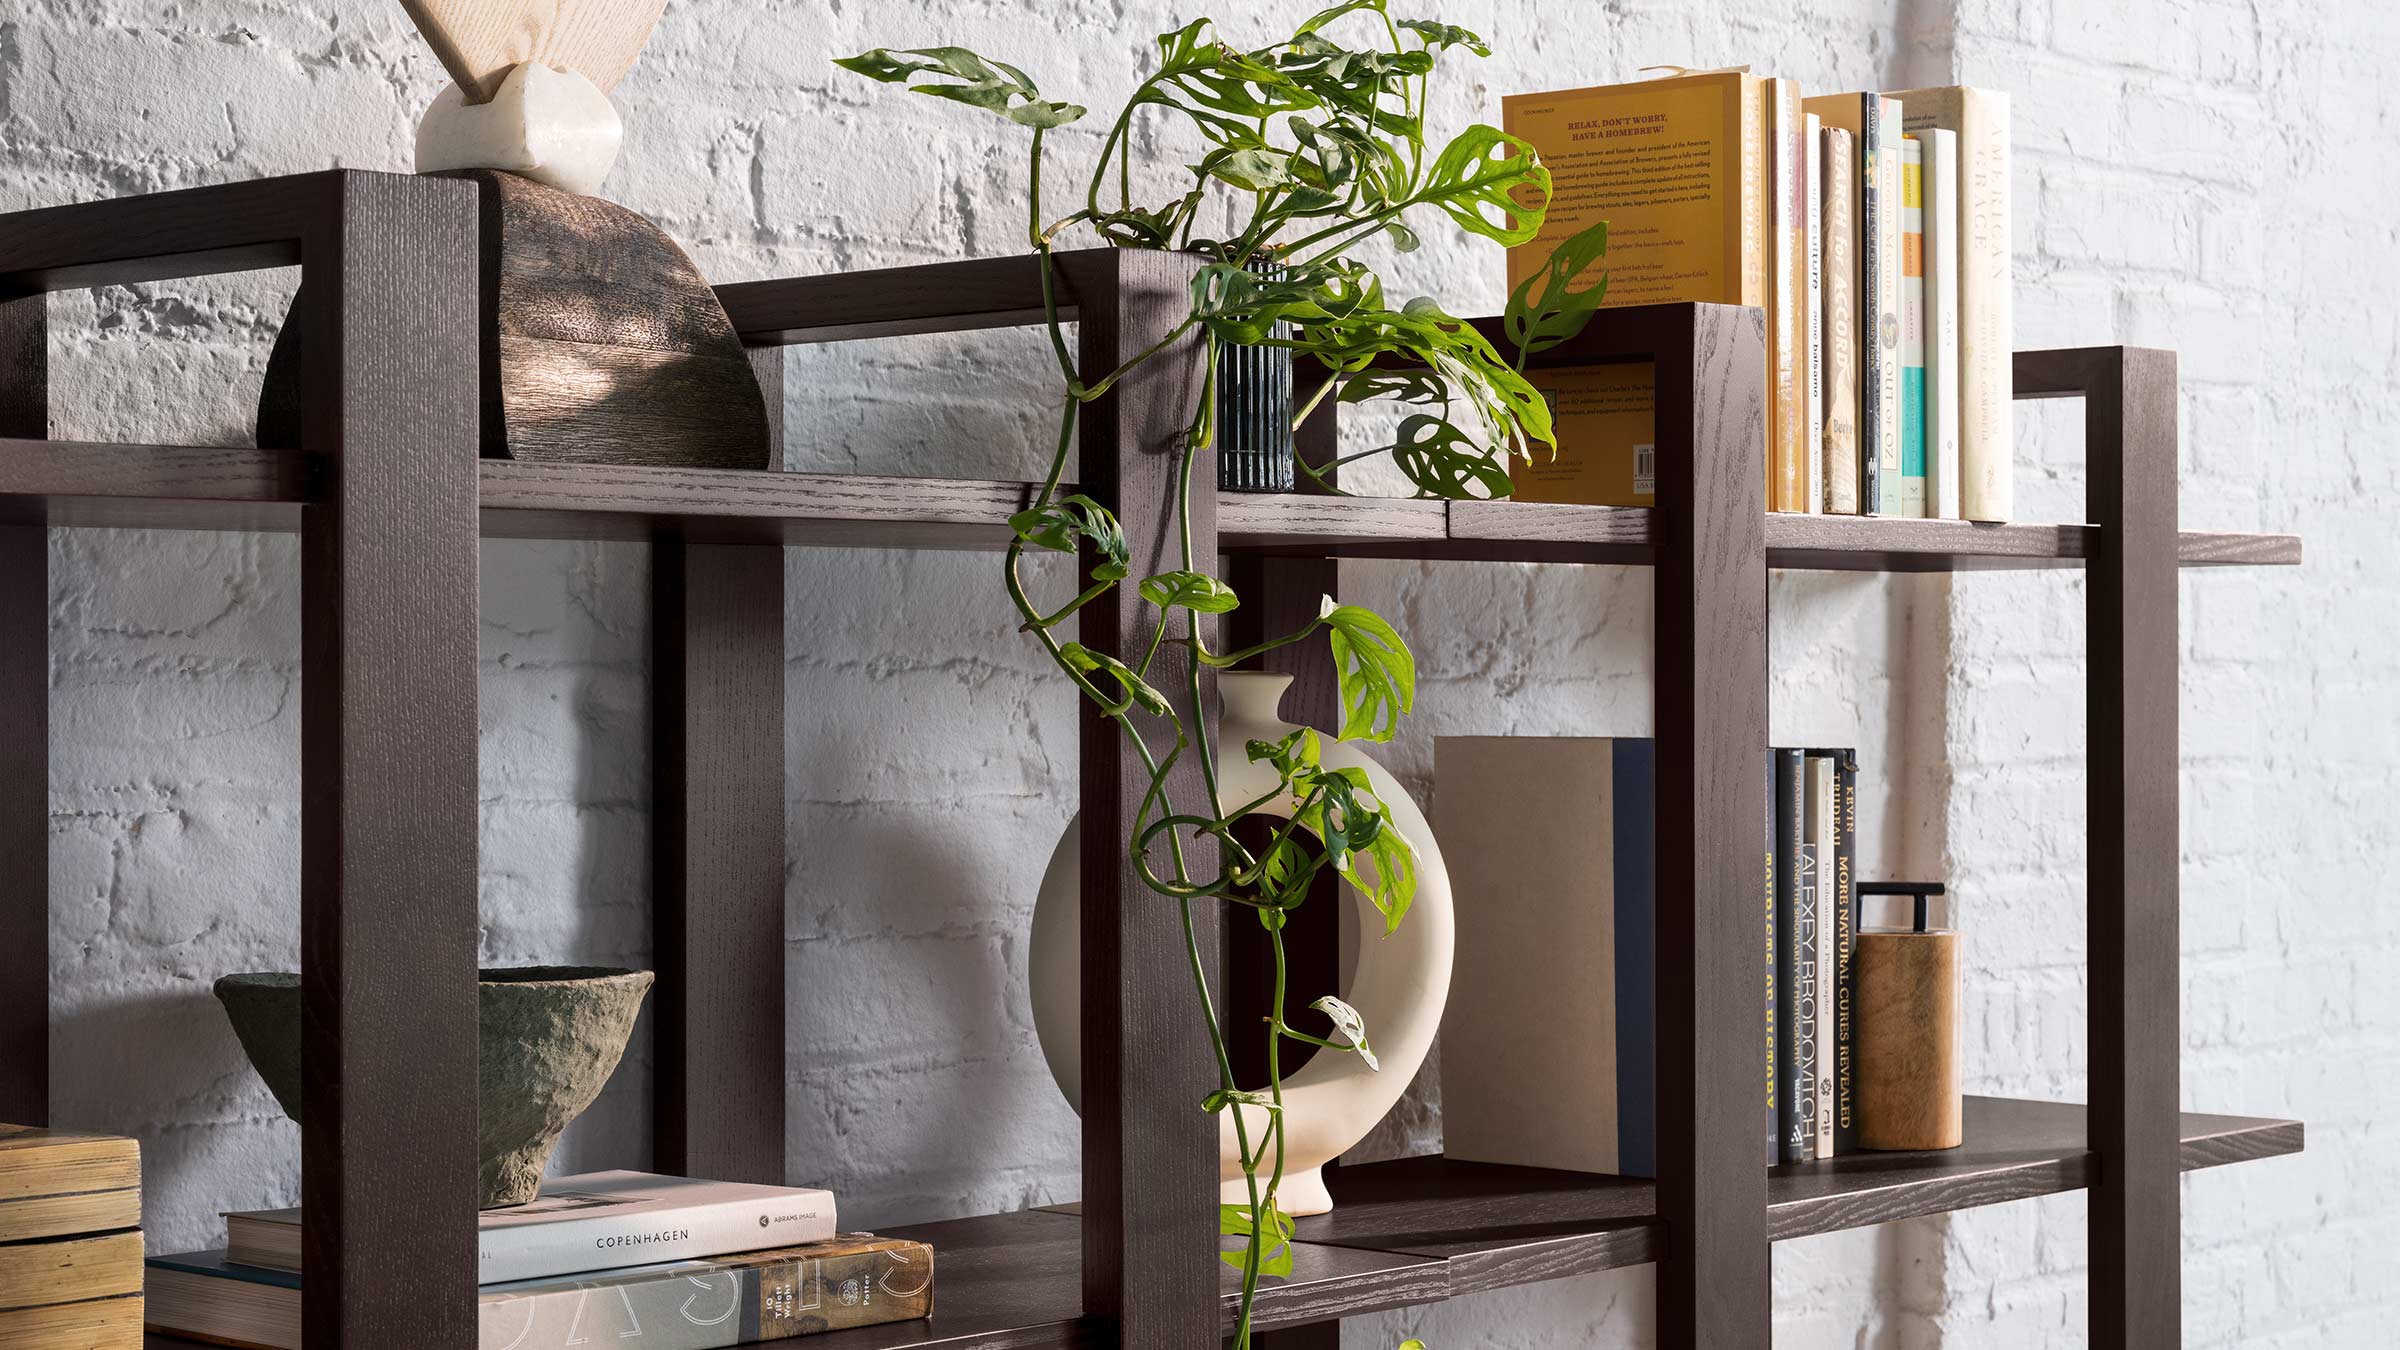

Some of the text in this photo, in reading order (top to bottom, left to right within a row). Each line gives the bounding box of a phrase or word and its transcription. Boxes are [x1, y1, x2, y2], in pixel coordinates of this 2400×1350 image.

[1568, 113, 1668, 131] RELAX, DON'T WORRY,
[1572, 132, 1596, 141] HAVE
[1606, 125, 1665, 138] HOMEBREW!
[1605, 147, 1615, 155] and
[1638, 144, 1647, 152] and
[1744, 93, 1754, 254] HOMEBREWING
[1975, 151, 1987, 250] GRACE
[1991, 123, 2003, 281] AMERICAN
[1834, 141, 1849, 368] SEARCH for ACCORD
[1884, 361, 1894, 404] OUT
[1884, 432, 1894, 461] OZ
[1833, 773, 1841, 847] TRUDEAU
[1846, 786, 1854, 833] KEVIN
[1793, 888, 1801, 905] THE
[1793, 907, 1801, 973] SINGULARITY
[1793, 975, 1801, 988] OF
[1823, 953, 1831, 1017] Photographer
[1838, 855, 1851, 1130] MORE NATURAL CURES REVEALED
[1793, 990, 1801, 1067] PHOTOGRAPHY
[596, 1229, 689, 1249] COPENHAGEN
[774, 1211, 817, 1224] ABRAMS IMAGE
[784, 1284, 793, 1319] Wright
[863, 1274, 871, 1306] Potter
